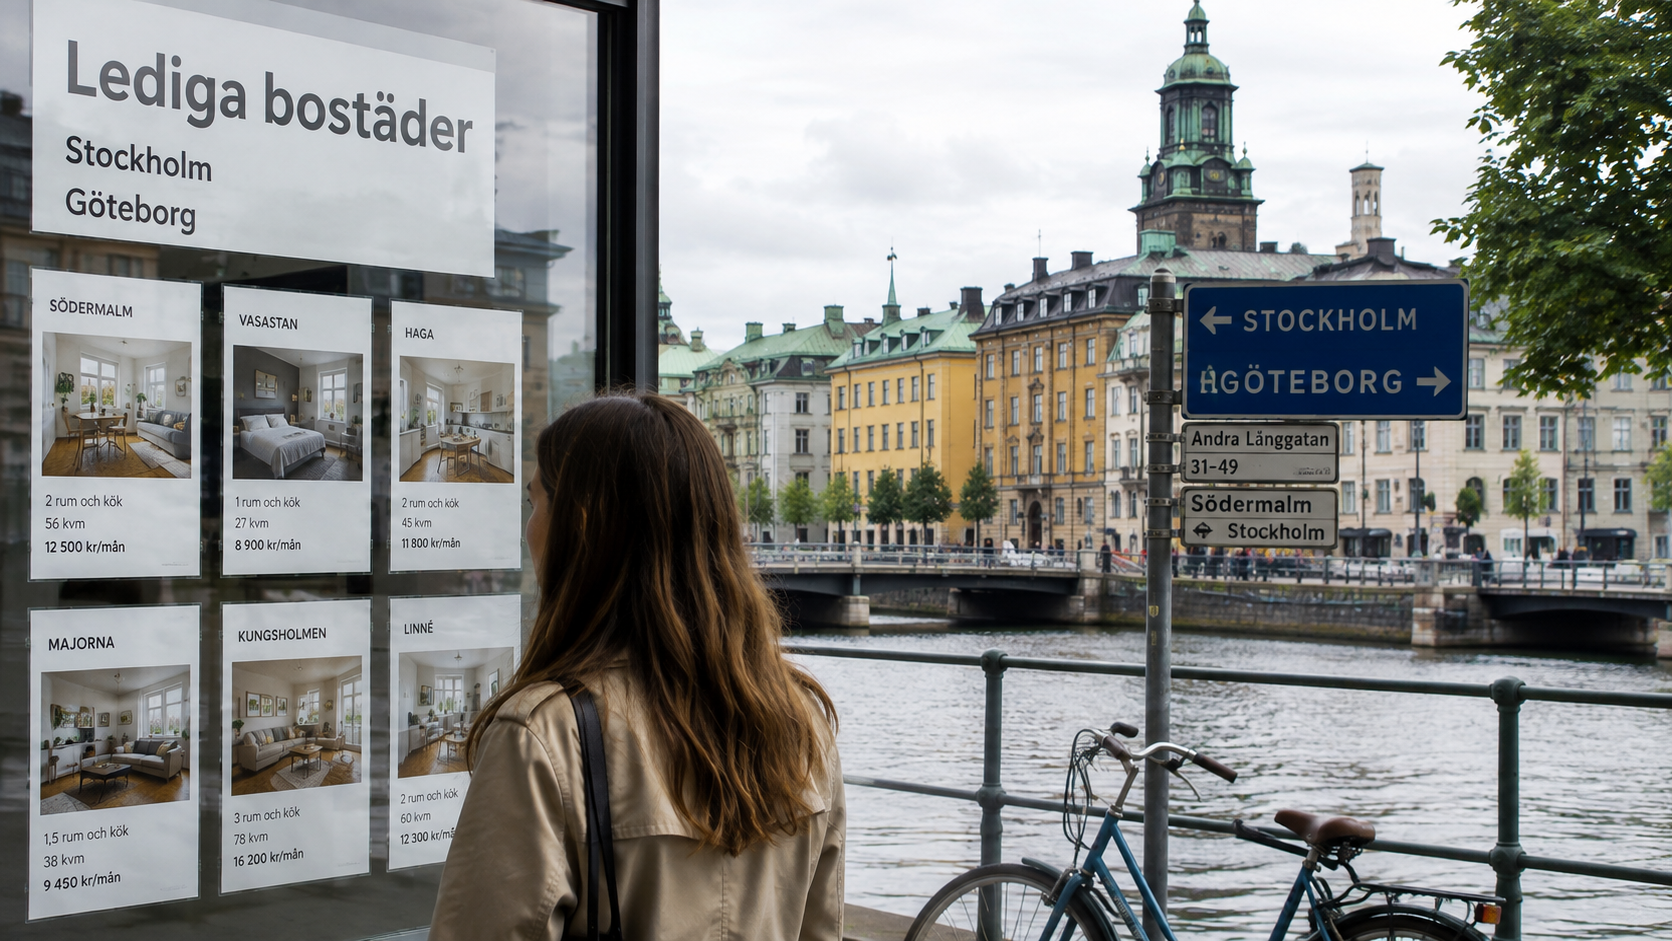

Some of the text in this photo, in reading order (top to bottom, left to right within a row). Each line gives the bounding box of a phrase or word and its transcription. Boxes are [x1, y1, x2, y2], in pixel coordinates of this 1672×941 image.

[68, 40, 472, 153] Lediga bostäder
[66, 136, 211, 181] Stockholm
[65, 188, 196, 235] Göteborg
[50, 297, 132, 317] SÖDERMALM
[239, 314, 297, 330] VASASTAN
[1244, 308, 1416, 332] STOCKHOLM
[406, 327, 434, 339] HAGA
[1191, 428, 1328, 450] Andra Långgatan
[1191, 459, 1238, 474] 31-49
[46, 495, 122, 507] 2 rum och kök
[236, 497, 239, 507] 1
[242, 499, 261, 507] rum
[264, 497, 281, 507] och
[402, 498, 407, 508] 2
[410, 500, 425, 508] rum
[428, 498, 443, 508] och
[1192, 494, 1311, 513] Södermalm
[46, 518, 85, 529] 56 kvm
[235, 517, 268, 528] 27 kvm
[402, 518, 431, 528] 45 kvm
[1228, 523, 1324, 540] Stockholm
[45, 540, 125, 553] 12 500 kr/mån
[235, 539, 301, 551] 8 900 kr/mån
[402, 538, 460, 549] 11 800 kr/mån
[405, 620, 433, 634] LINNÉ
[239, 628, 326, 642] KUNGSHOLMEN
[49, 636, 114, 651] MAJORNA
[401, 794, 405, 804] 2
[408, 794, 424, 803] rum
[427, 790, 441, 801] och
[234, 813, 240, 823] 3
[243, 813, 261, 822] rum
[264, 809, 281, 820] och
[401, 812, 431, 824] 60 kvm
[44, 825, 128, 846] 1,5 rum och kök
[234, 833, 268, 845] 78 kvm
[401, 827, 455, 845] 12 300 kr/må
[44, 854, 84, 868] 38 kvm
[234, 848, 303, 867] 16 200 kr/mån
[44, 880, 51, 891] 9
[54, 877, 77, 890] 450
